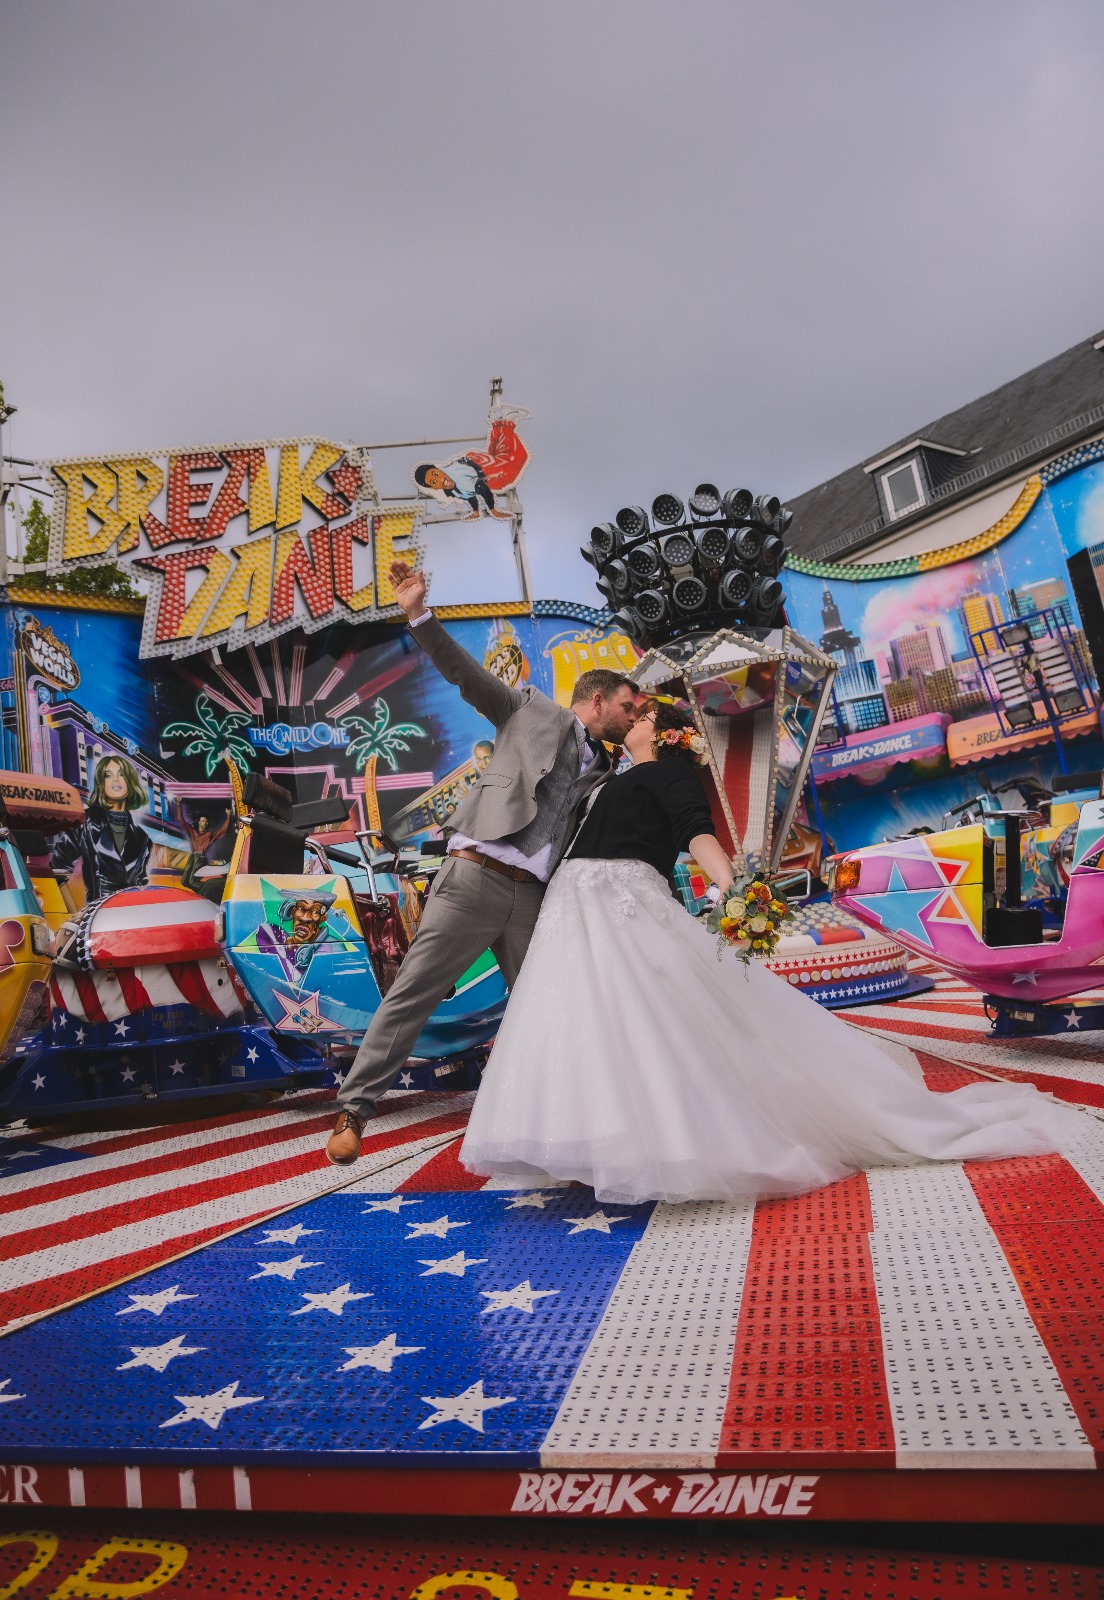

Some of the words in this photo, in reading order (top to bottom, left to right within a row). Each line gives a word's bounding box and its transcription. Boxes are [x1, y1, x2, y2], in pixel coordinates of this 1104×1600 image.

[51, 443, 352, 560] BREAK
[131, 507, 418, 644] DANCE
[29, 647, 76, 686] WORLD
[31, 632, 72, 671] VEGAS
[251, 728, 272, 742] THE
[272, 723, 311, 751] WILD
[311, 722, 348, 745] ONE
[831, 746, 871, 767] BREAK
[872, 735, 912, 757] DANCE
[976, 727, 1010, 746] BREA
[32, 788, 66, 804] DANCE
[510, 1472, 656, 1513] BREAK
[671, 1473, 820, 1516] DANCE
